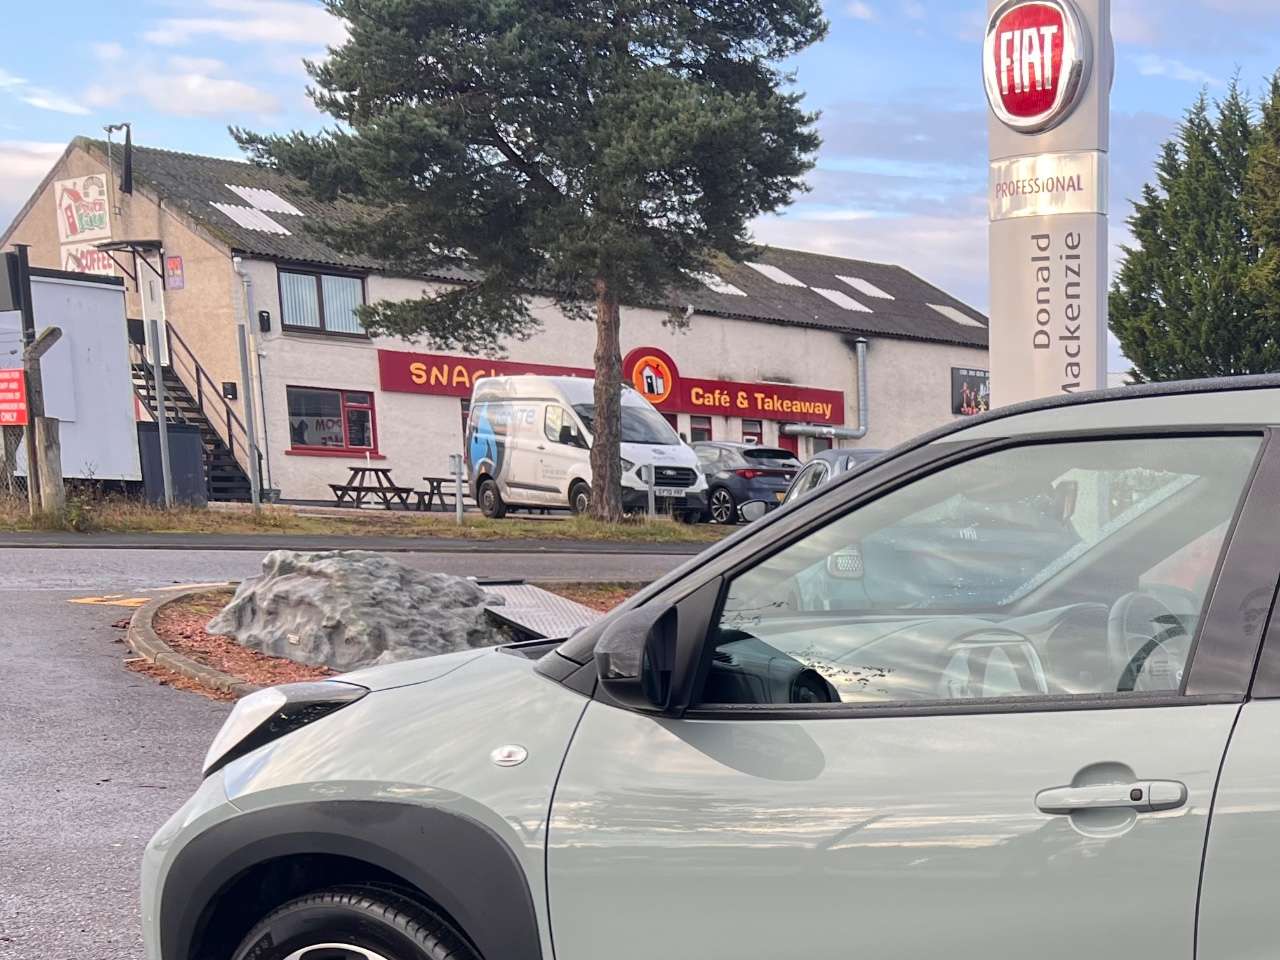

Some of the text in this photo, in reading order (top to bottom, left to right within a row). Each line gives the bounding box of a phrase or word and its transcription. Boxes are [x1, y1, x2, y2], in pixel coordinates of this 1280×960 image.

[1000, 25, 1058, 95] FIAT
[995, 174, 1084, 198] PROFESSIONAL
[1031, 233, 1050, 350] Donald
[409, 362, 495, 388] SNAC
[690, 386, 832, 419] Café & Takeaway
